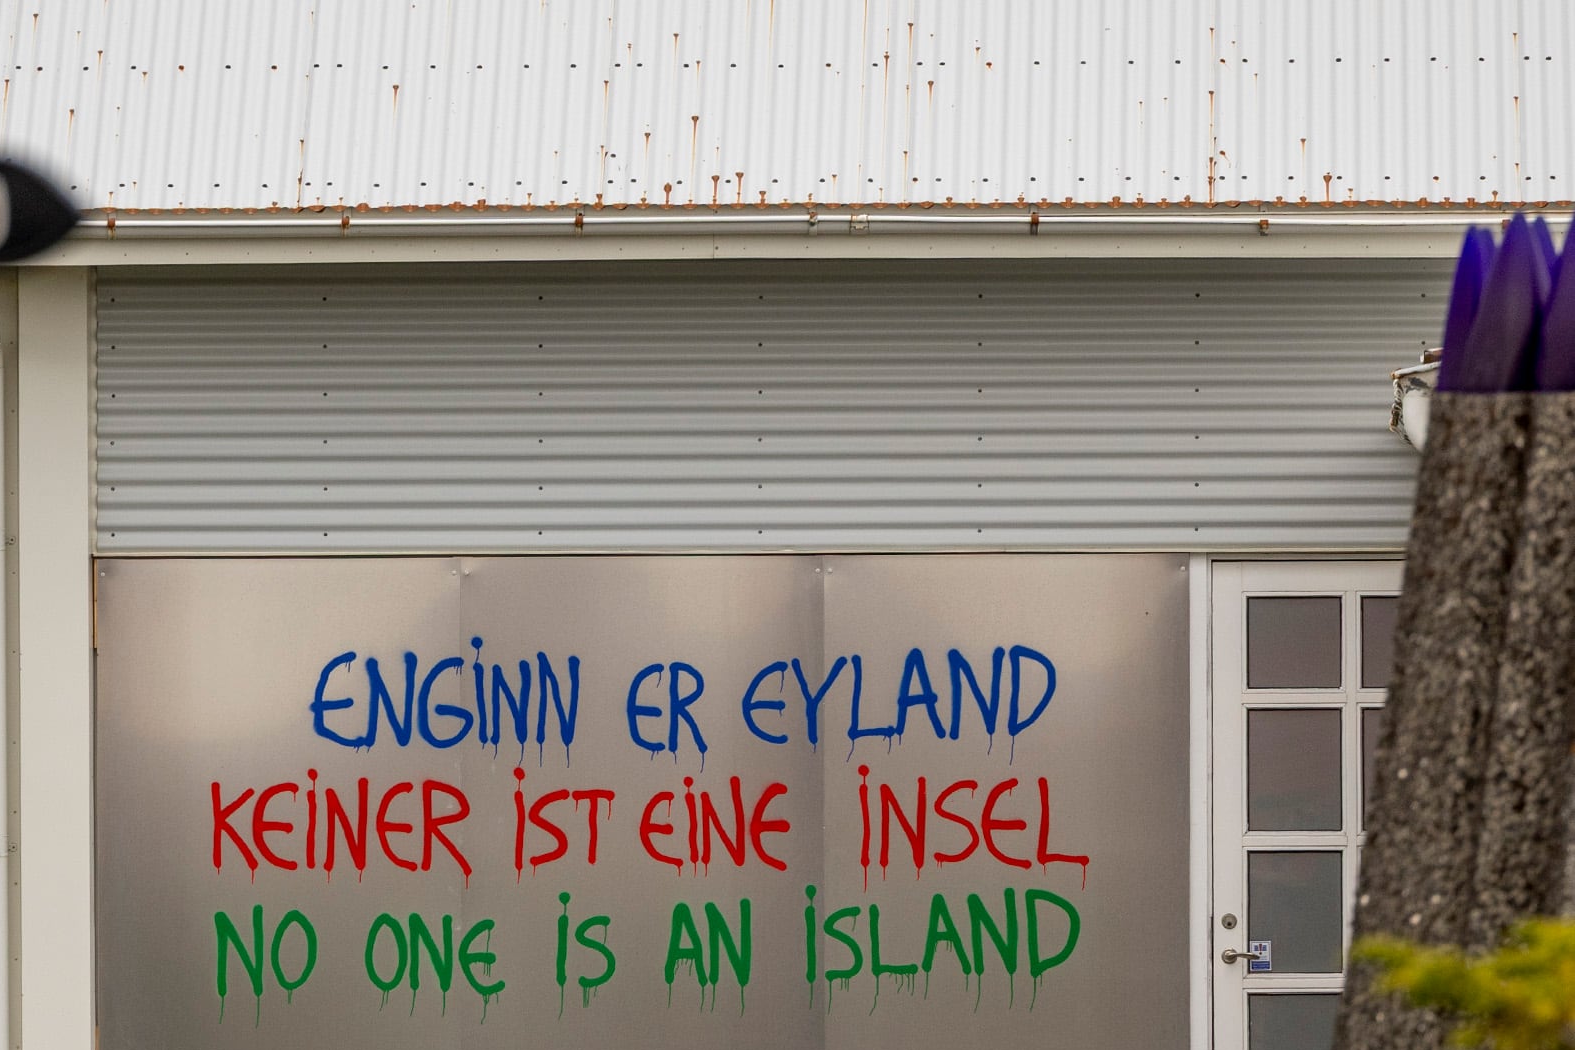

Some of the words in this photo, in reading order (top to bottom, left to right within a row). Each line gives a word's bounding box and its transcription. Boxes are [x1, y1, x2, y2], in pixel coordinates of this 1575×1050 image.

[626, 662, 708, 758] ER
[741, 646, 1057, 750] EYLAND
[213, 903, 318, 1000] NO
[364, 911, 506, 1004] ONE
[664, 898, 752, 1000] AN
